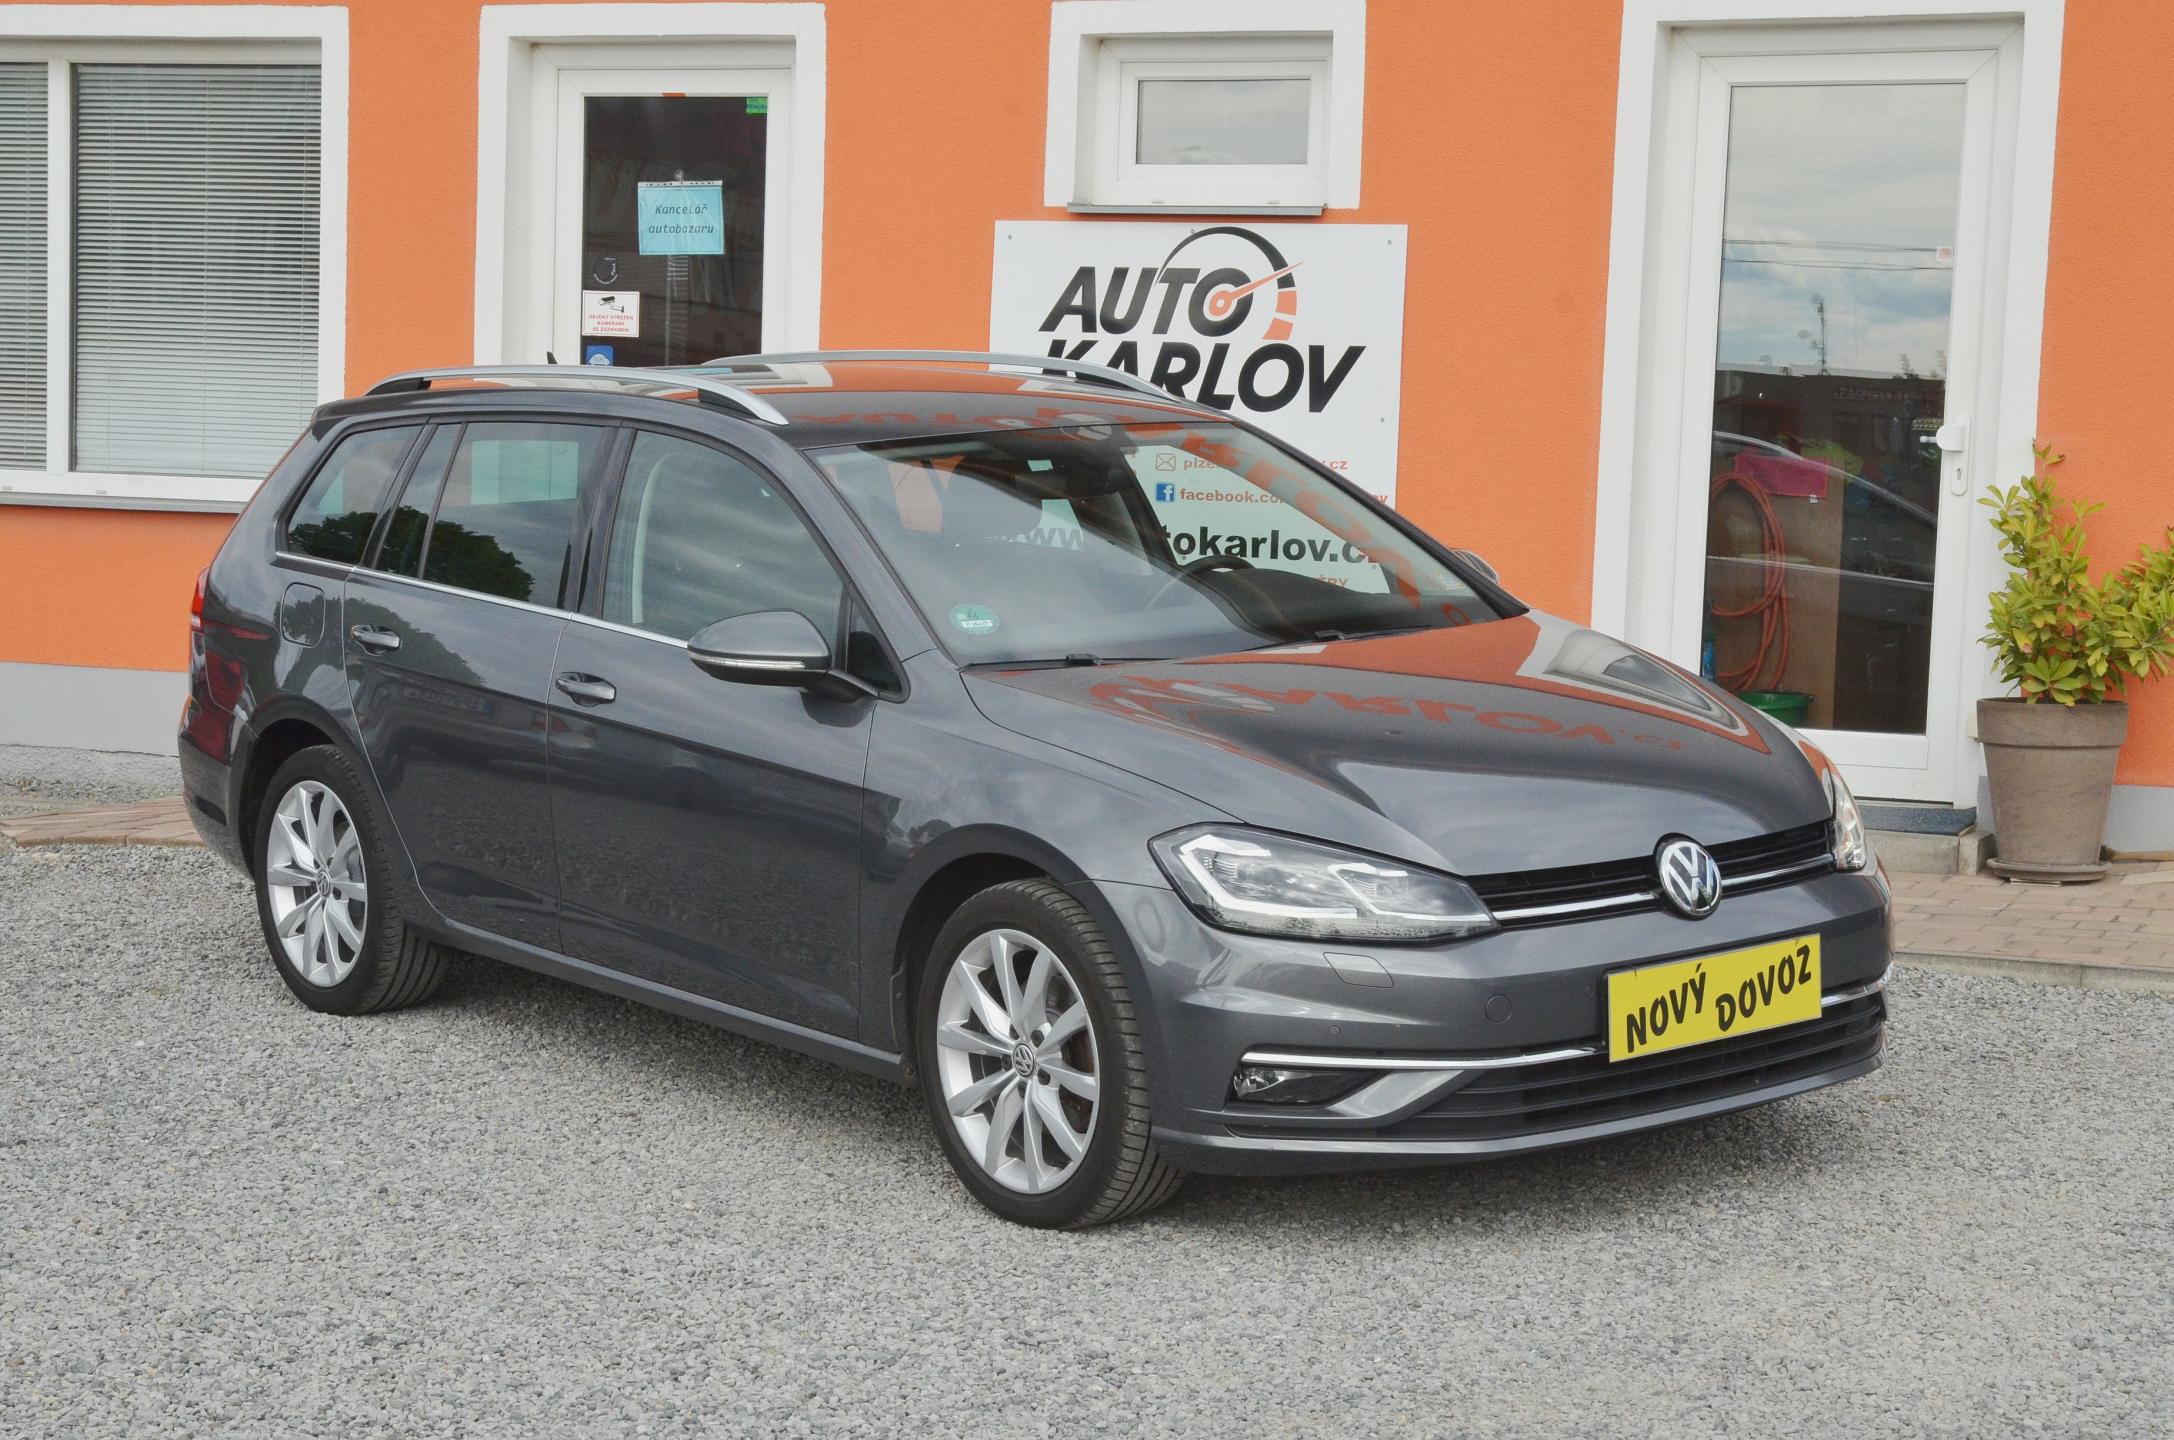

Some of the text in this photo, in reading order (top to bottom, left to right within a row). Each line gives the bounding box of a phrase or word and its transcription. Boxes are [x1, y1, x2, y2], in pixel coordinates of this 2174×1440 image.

[648, 223, 714, 234] autobazaru
[654, 202, 708, 215] Kancelář
[1038, 266, 1253, 337] AUTO
[1041, 339, 1367, 413] KARLOV
[1180, 488, 1286, 504] facebook.co
[1626, 944, 1811, 1053] NOVÝ DOVOZ
